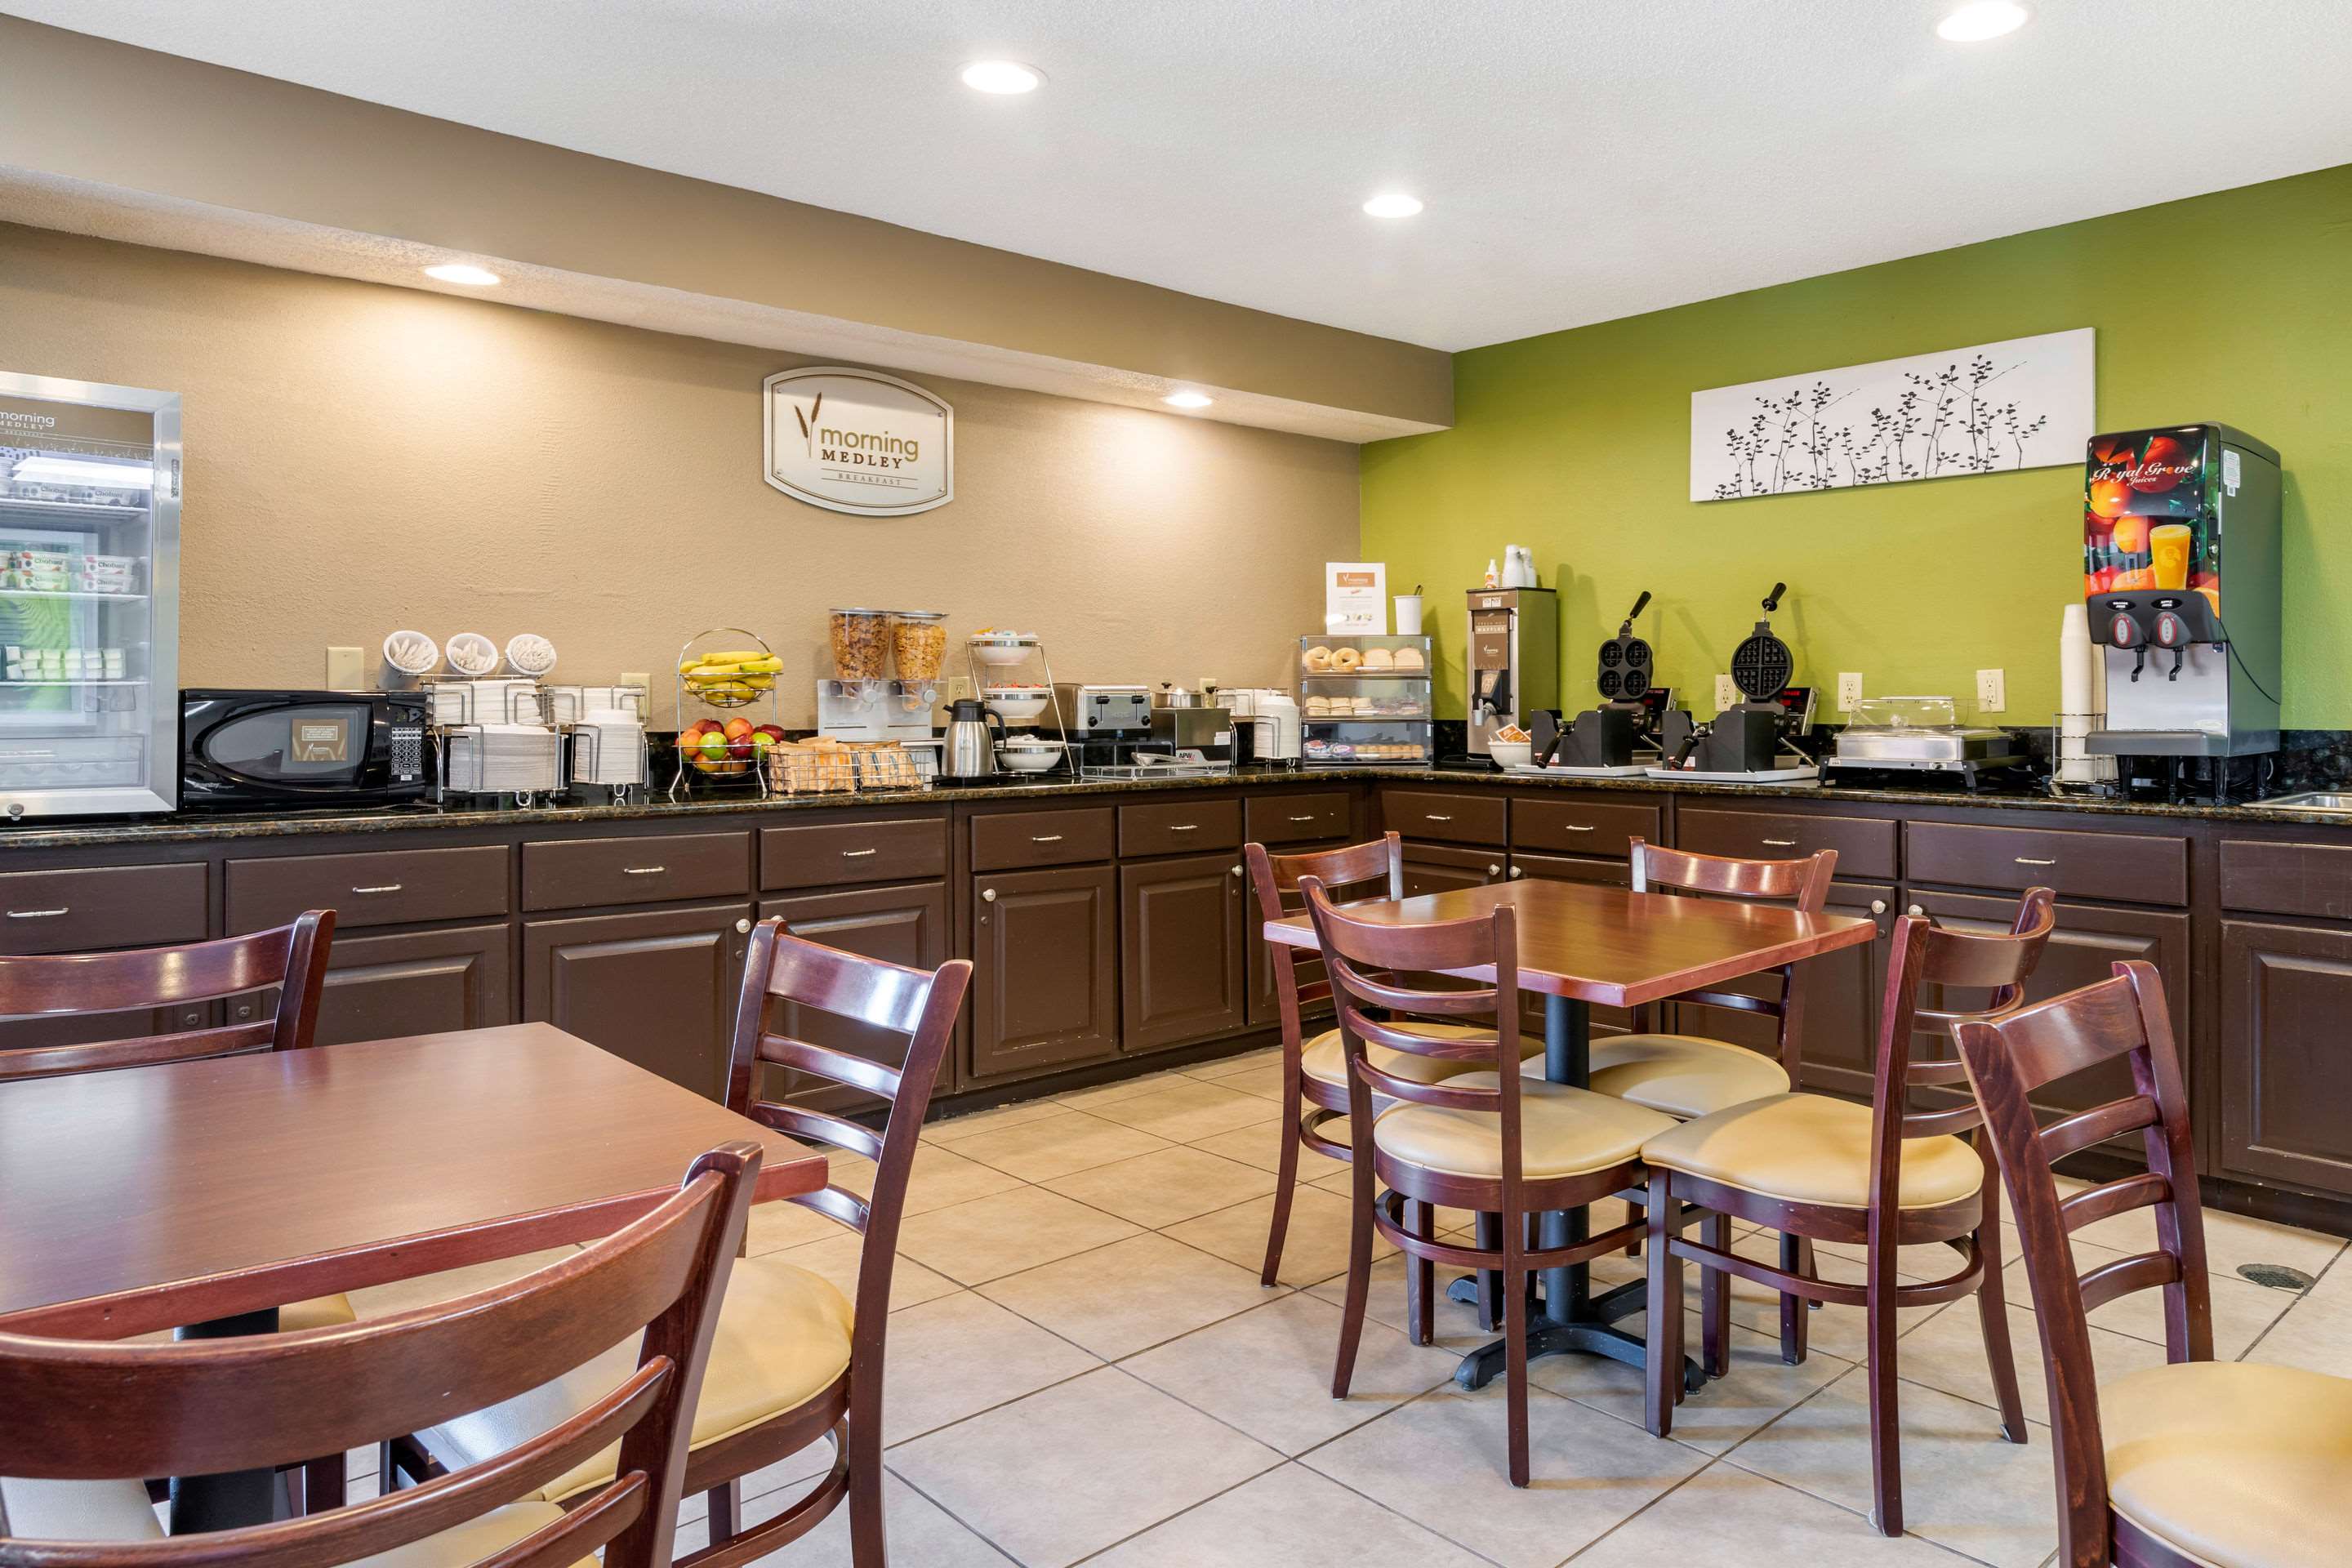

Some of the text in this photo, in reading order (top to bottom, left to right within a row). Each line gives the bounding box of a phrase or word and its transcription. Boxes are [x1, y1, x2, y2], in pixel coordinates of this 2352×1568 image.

[821, 428, 918, 461] morning
[822, 449, 902, 469] MEDLEY
[838, 473, 902, 485] BREAKFAST
